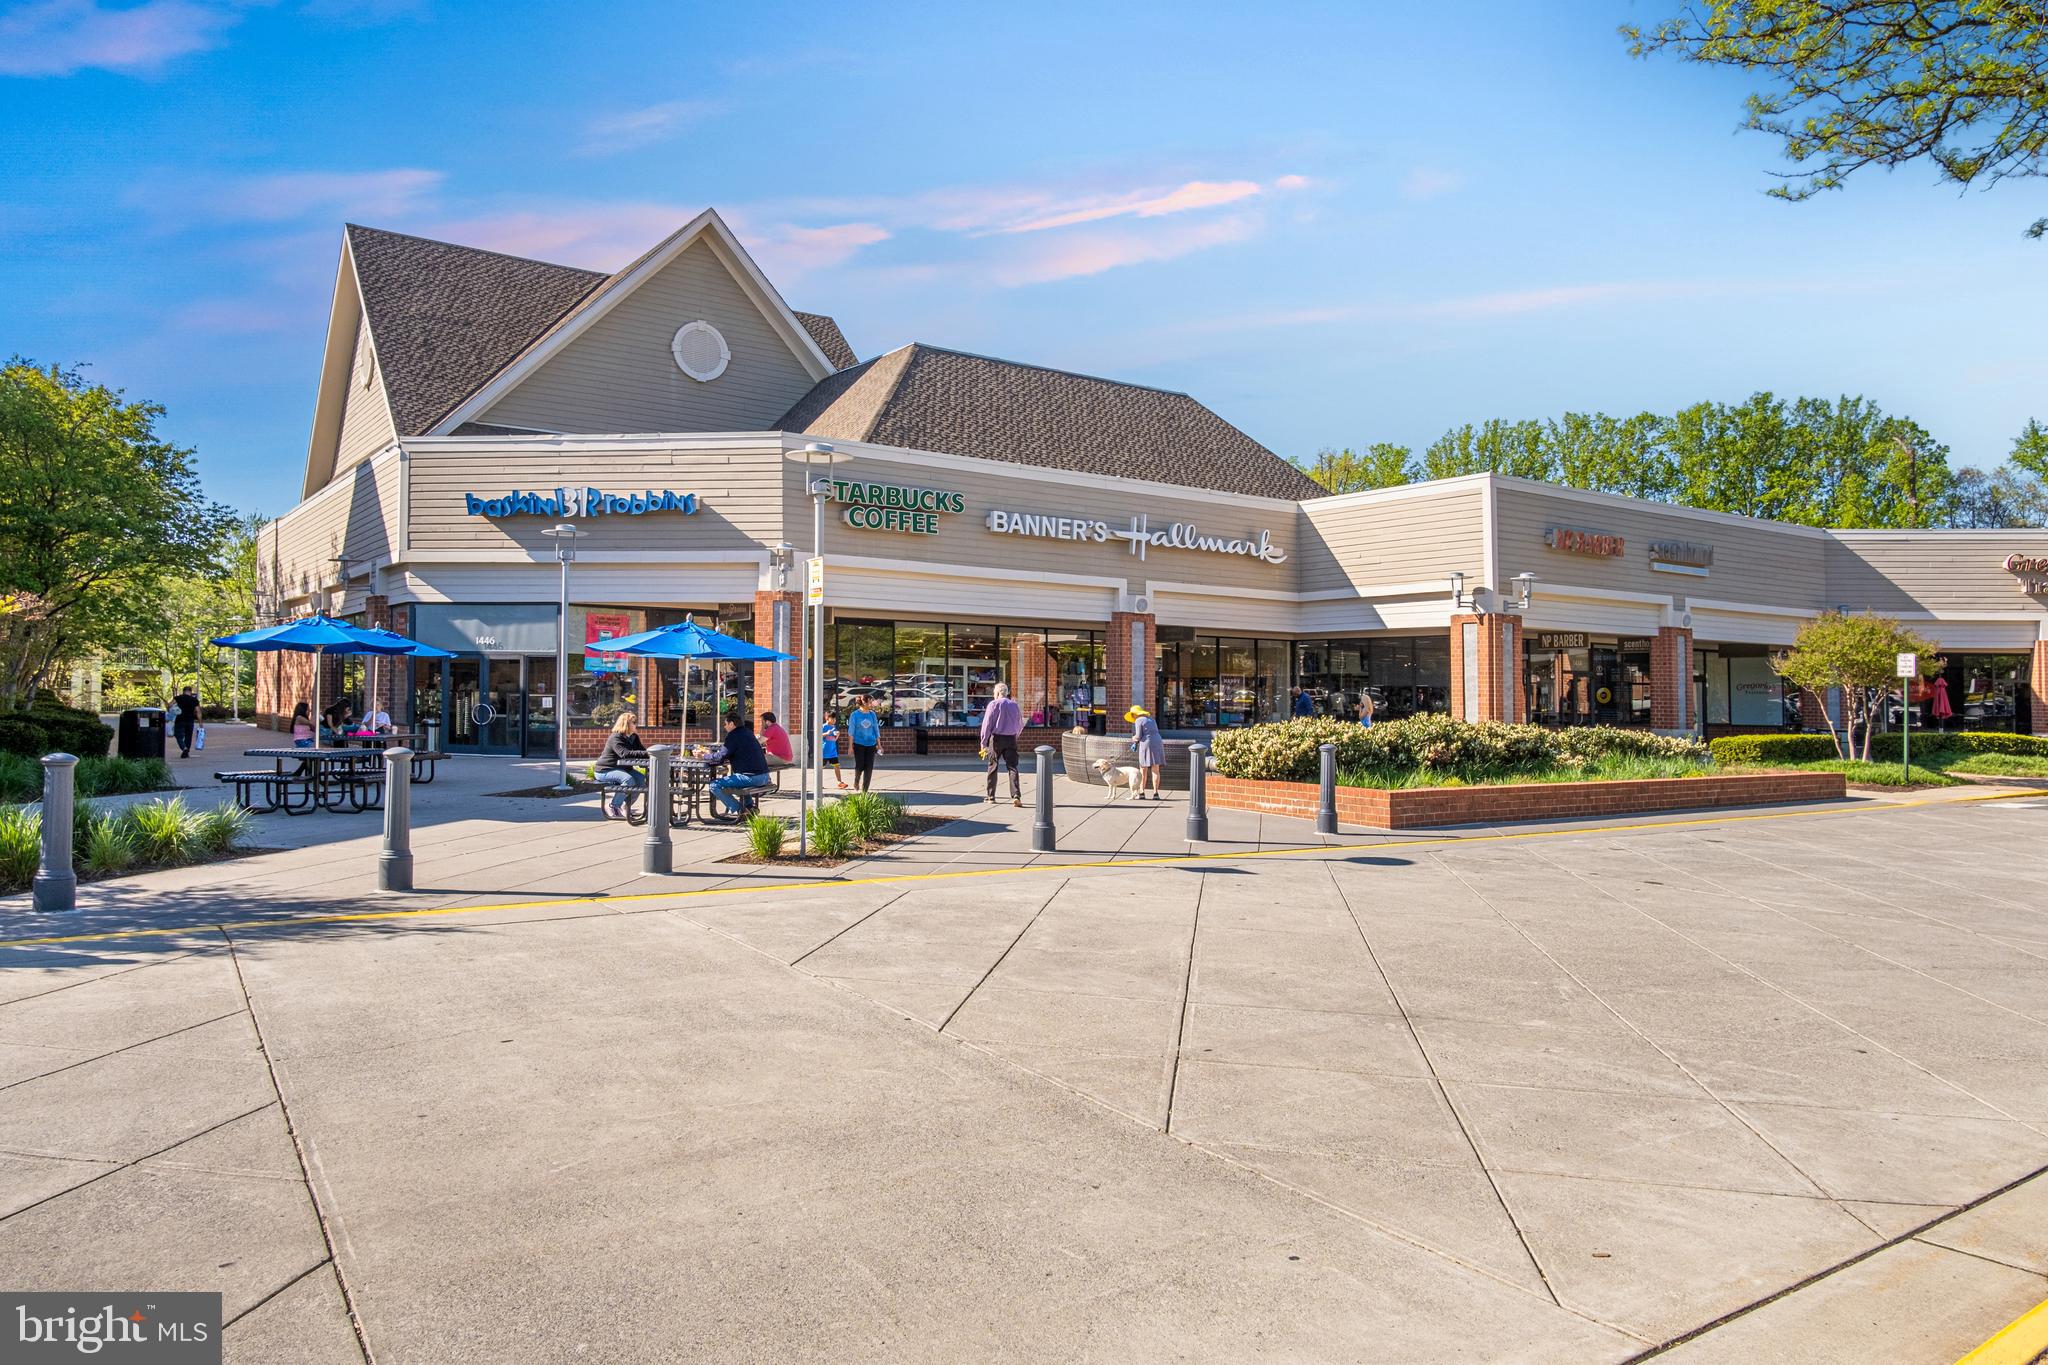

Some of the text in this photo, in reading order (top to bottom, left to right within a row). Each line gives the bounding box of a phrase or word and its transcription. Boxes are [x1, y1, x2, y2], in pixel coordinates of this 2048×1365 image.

[465, 489, 554, 517] baskin
[603, 489, 697, 515] robbins
[849, 505, 940, 536] COFFEE
[989, 510, 1288, 564] BANNER'S Hallmark
[475, 636, 496, 645] 1446
[1541, 634, 1584, 648] NP BARBER
